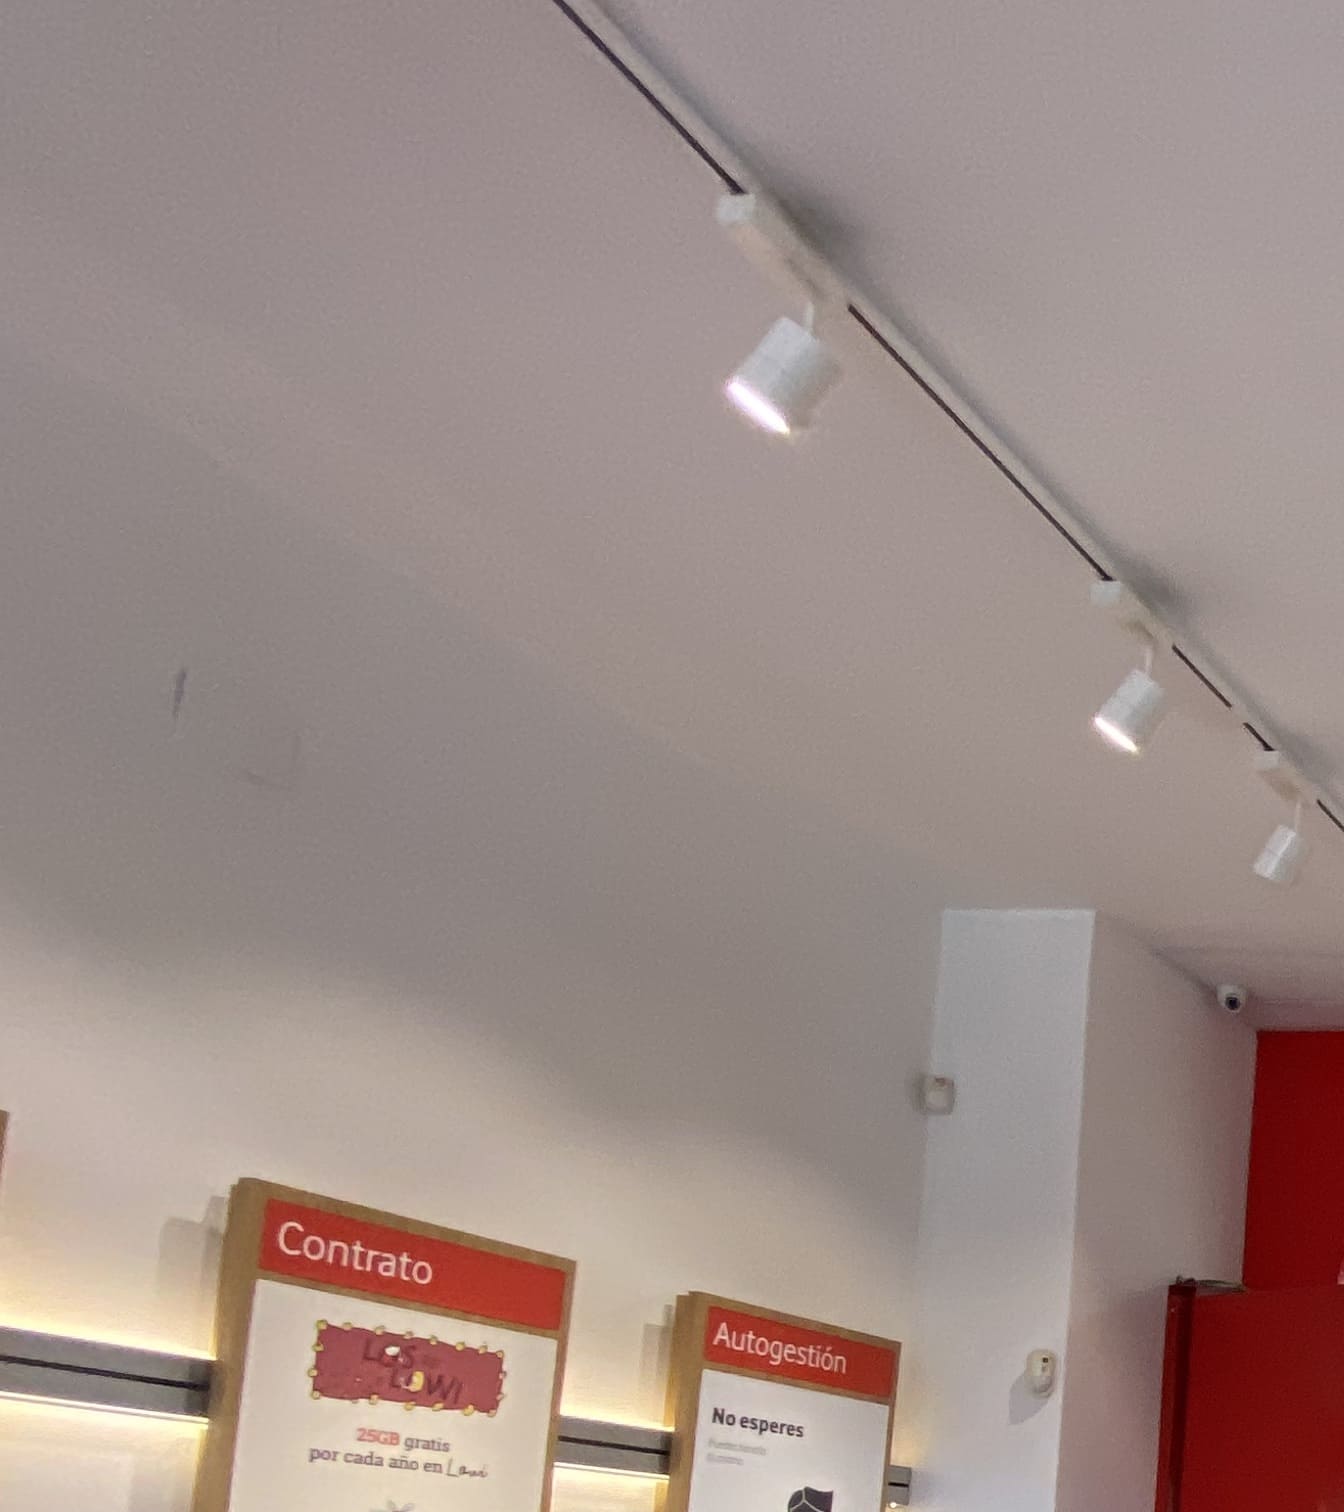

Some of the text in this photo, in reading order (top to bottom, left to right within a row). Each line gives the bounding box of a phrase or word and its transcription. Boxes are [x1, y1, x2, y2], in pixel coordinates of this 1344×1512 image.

[277, 1221, 433, 1285] Contrato
[712, 1322, 847, 1374] Autogestión
[712, 1407, 804, 1437] No esperes
[357, 1428, 450, 1453] 25GB gratis
[308, 1448, 339, 1463] por
[343, 1451, 384, 1467] cada
[388, 1455, 419, 1471] año
[423, 1462, 443, 1474] en
